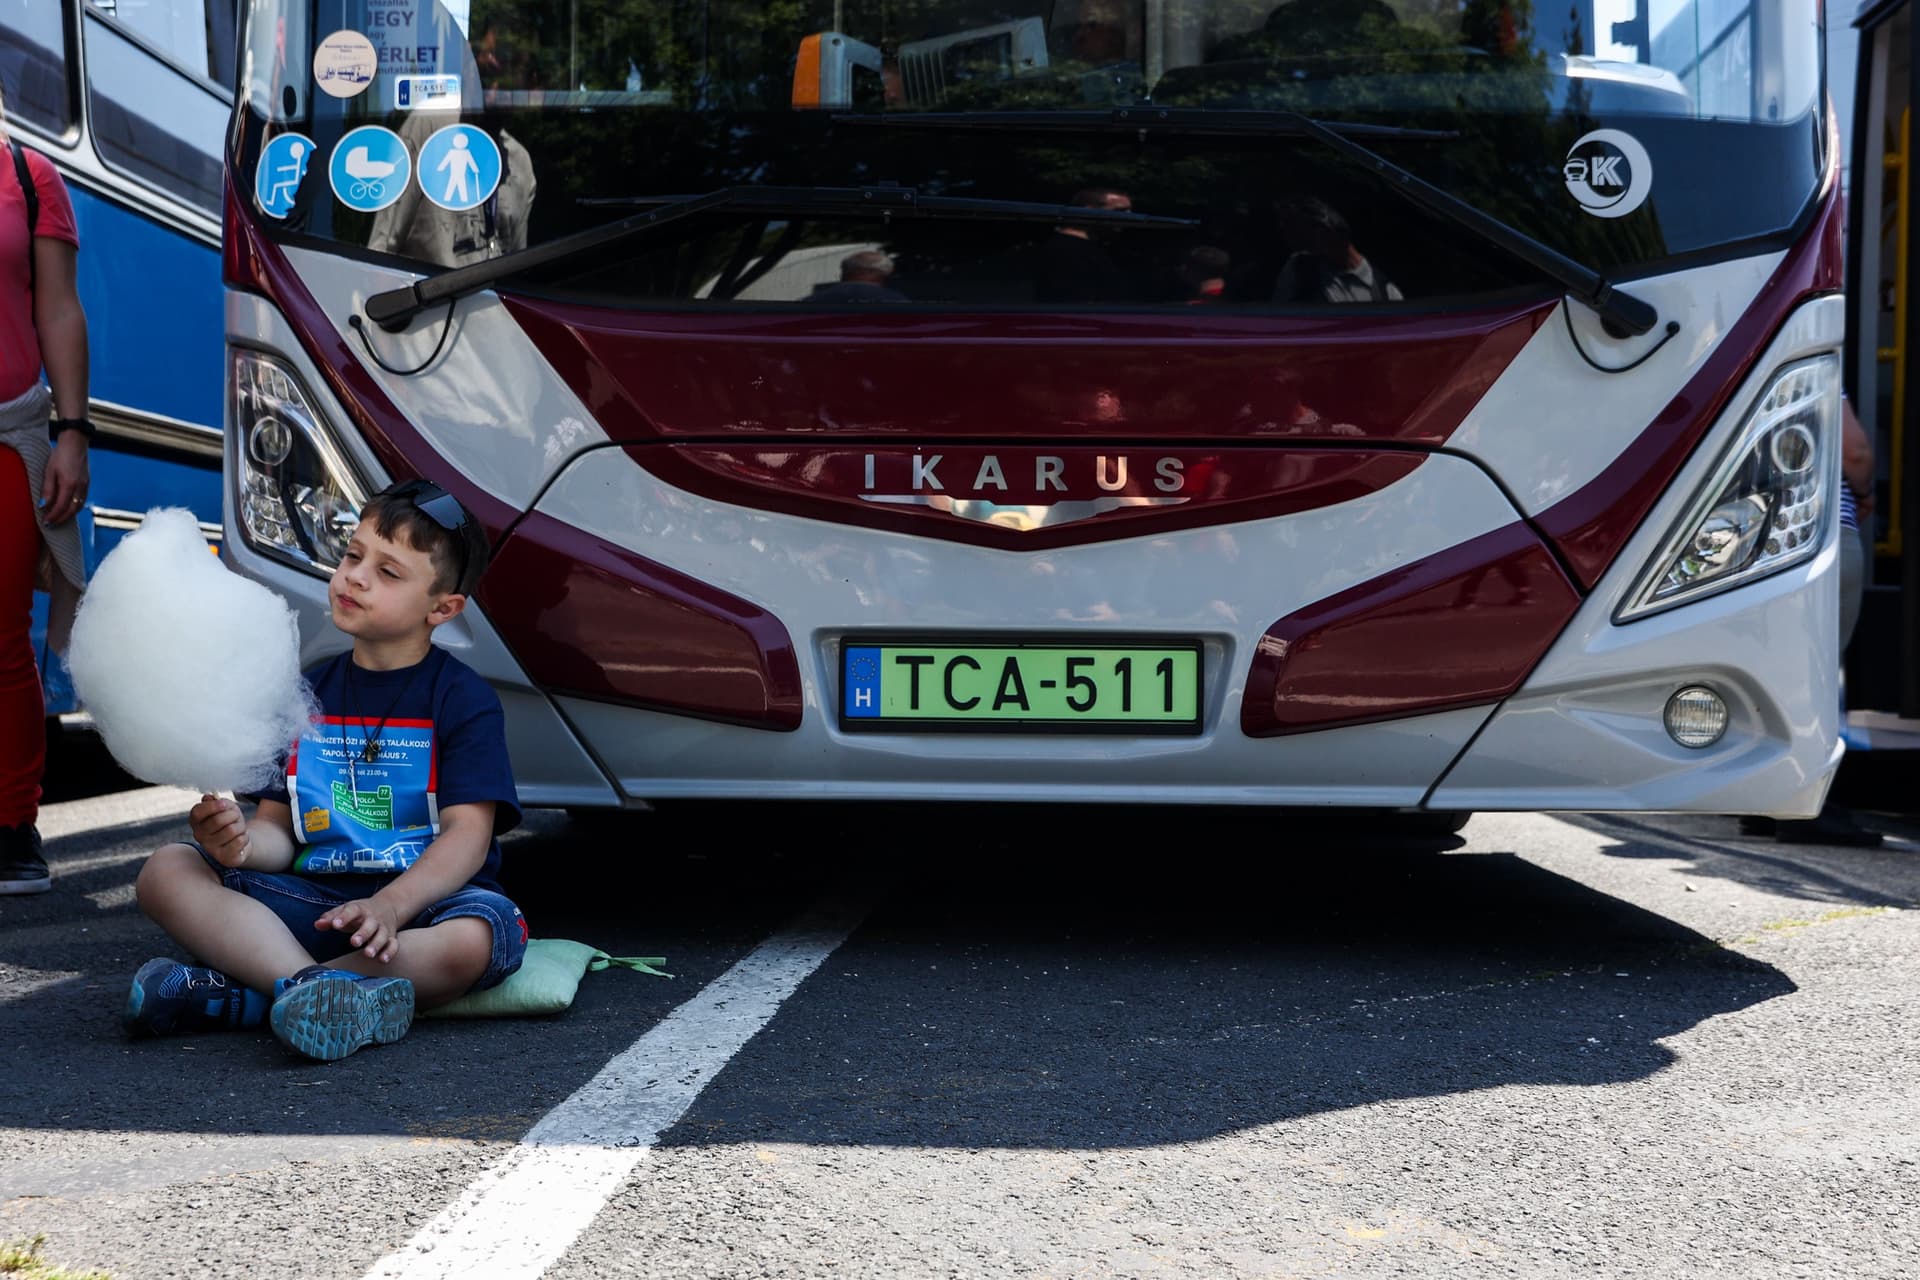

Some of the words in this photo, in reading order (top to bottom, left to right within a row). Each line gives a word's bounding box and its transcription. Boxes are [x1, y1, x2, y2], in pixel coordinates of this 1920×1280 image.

[367, 10, 415, 27] JEGY
[378, 41, 440, 63] ÉRLET
[864, 454, 1185, 492] IKARUS
[855, 687, 872, 707] H
[895, 655, 1174, 713] TCA-511
[359, 738, 386, 746] IKUS
[387, 738, 431, 749] TALÁLKOZÓ
[356, 808, 389, 817] ALÁLKOZÓ
